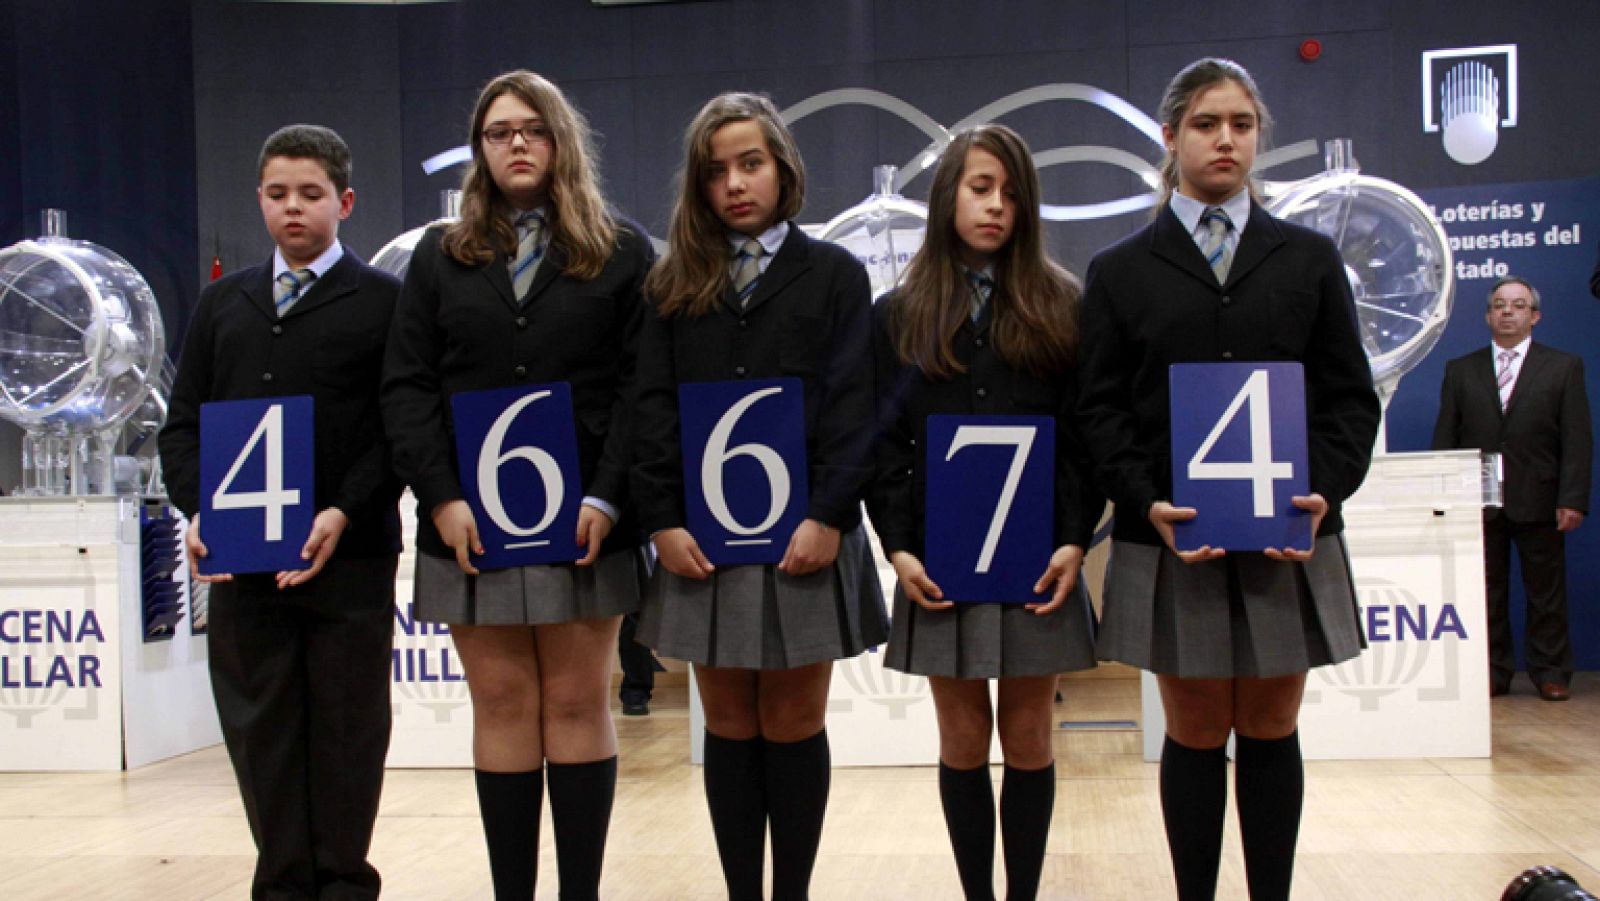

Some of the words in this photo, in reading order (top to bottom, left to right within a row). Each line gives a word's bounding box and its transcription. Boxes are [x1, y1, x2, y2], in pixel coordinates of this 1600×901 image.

[1531, 202, 1545, 222] y
[1449, 228, 1536, 251] puestas
[1543, 223, 1580, 245] del
[1456, 258, 1509, 280] tado
[478, 389, 564, 536] 6
[702, 387, 790, 535] 6
[1188, 369, 1294, 518] 4
[212, 404, 300, 541] 4
[945, 425, 1037, 574] 7
[0, 609, 105, 643] CENA
[1360, 603, 1469, 641] ENA
[1, 655, 102, 688] LLAR
